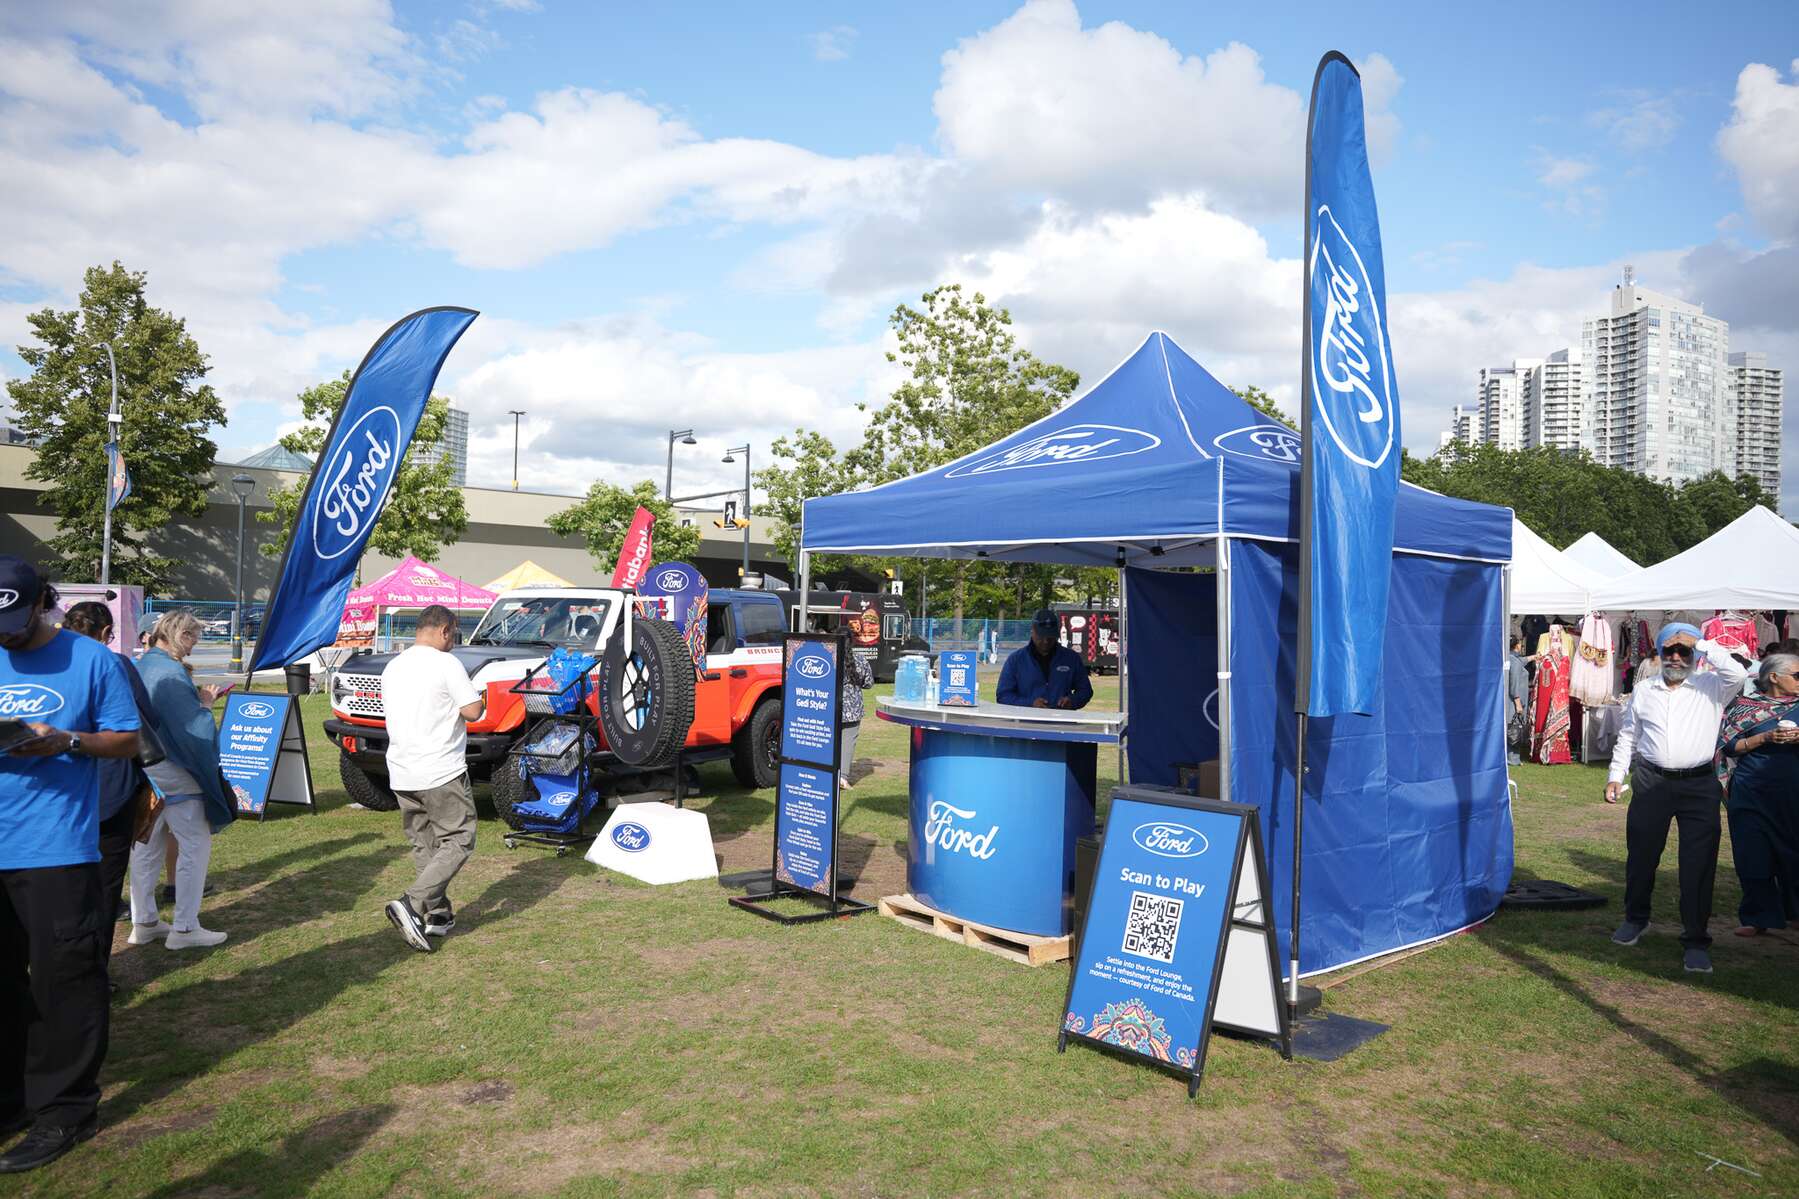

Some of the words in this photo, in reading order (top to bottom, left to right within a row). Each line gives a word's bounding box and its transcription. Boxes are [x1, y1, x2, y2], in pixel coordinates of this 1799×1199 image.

[1320, 242, 1383, 423] Ford
[971, 431, 1120, 472] Ford
[323, 429, 391, 537] Ford
[662, 573, 684, 589] Ford
[388, 592, 413, 602] Fresh
[417, 594, 434, 602] Hot
[437, 595, 458, 603] Mini
[461, 595, 493, 604] Donuts
[639, 636, 656, 663] BUILT
[603, 661, 611, 691] PLAY
[651, 663, 661, 690] FOR
[802, 659, 824, 674] Ford
[0, 688, 47, 714] Ford
[796, 688, 815, 698] What's
[815, 689, 829, 699] Your
[809, 699, 828, 711] Style?
[245, 704, 268, 716] Ford
[602, 697, 611, 723] FOR
[651, 694, 662, 727] PLAY
[242, 735, 268, 744] Affinity
[252, 726, 273, 734] about
[606, 721, 623, 749] BUILT
[231, 743, 264, 751] Programs!
[616, 824, 646, 849] Ford
[924, 800, 999, 860] Ford
[1145, 825, 1194, 855] Ford
[1120, 867, 1152, 886] Scan
[1155, 873, 1170, 890] to
[1174, 877, 1206, 898] Play
[1095, 962, 1104, 970] sip
[1117, 967, 1152, 982] refreshment,
[1152, 976, 1164, 985] and
[1164, 980, 1182, 990] enjoy
[1182, 984, 1193, 993] the
[1106, 956, 1123, 965] Settle
[1123, 960, 1135, 968] into
[1135, 963, 1145, 971] the
[1146, 966, 1159, 975] Ford
[1160, 970, 1183, 982] Lounge,
[1089, 969, 1112, 980] moment
[1119, 977, 1143, 989] courtesy
[1143, 982, 1151, 990] of
[1150, 984, 1164, 994] Ford
[1164, 987, 1172, 996] of
[1172, 990, 1196, 1002] Canada.
